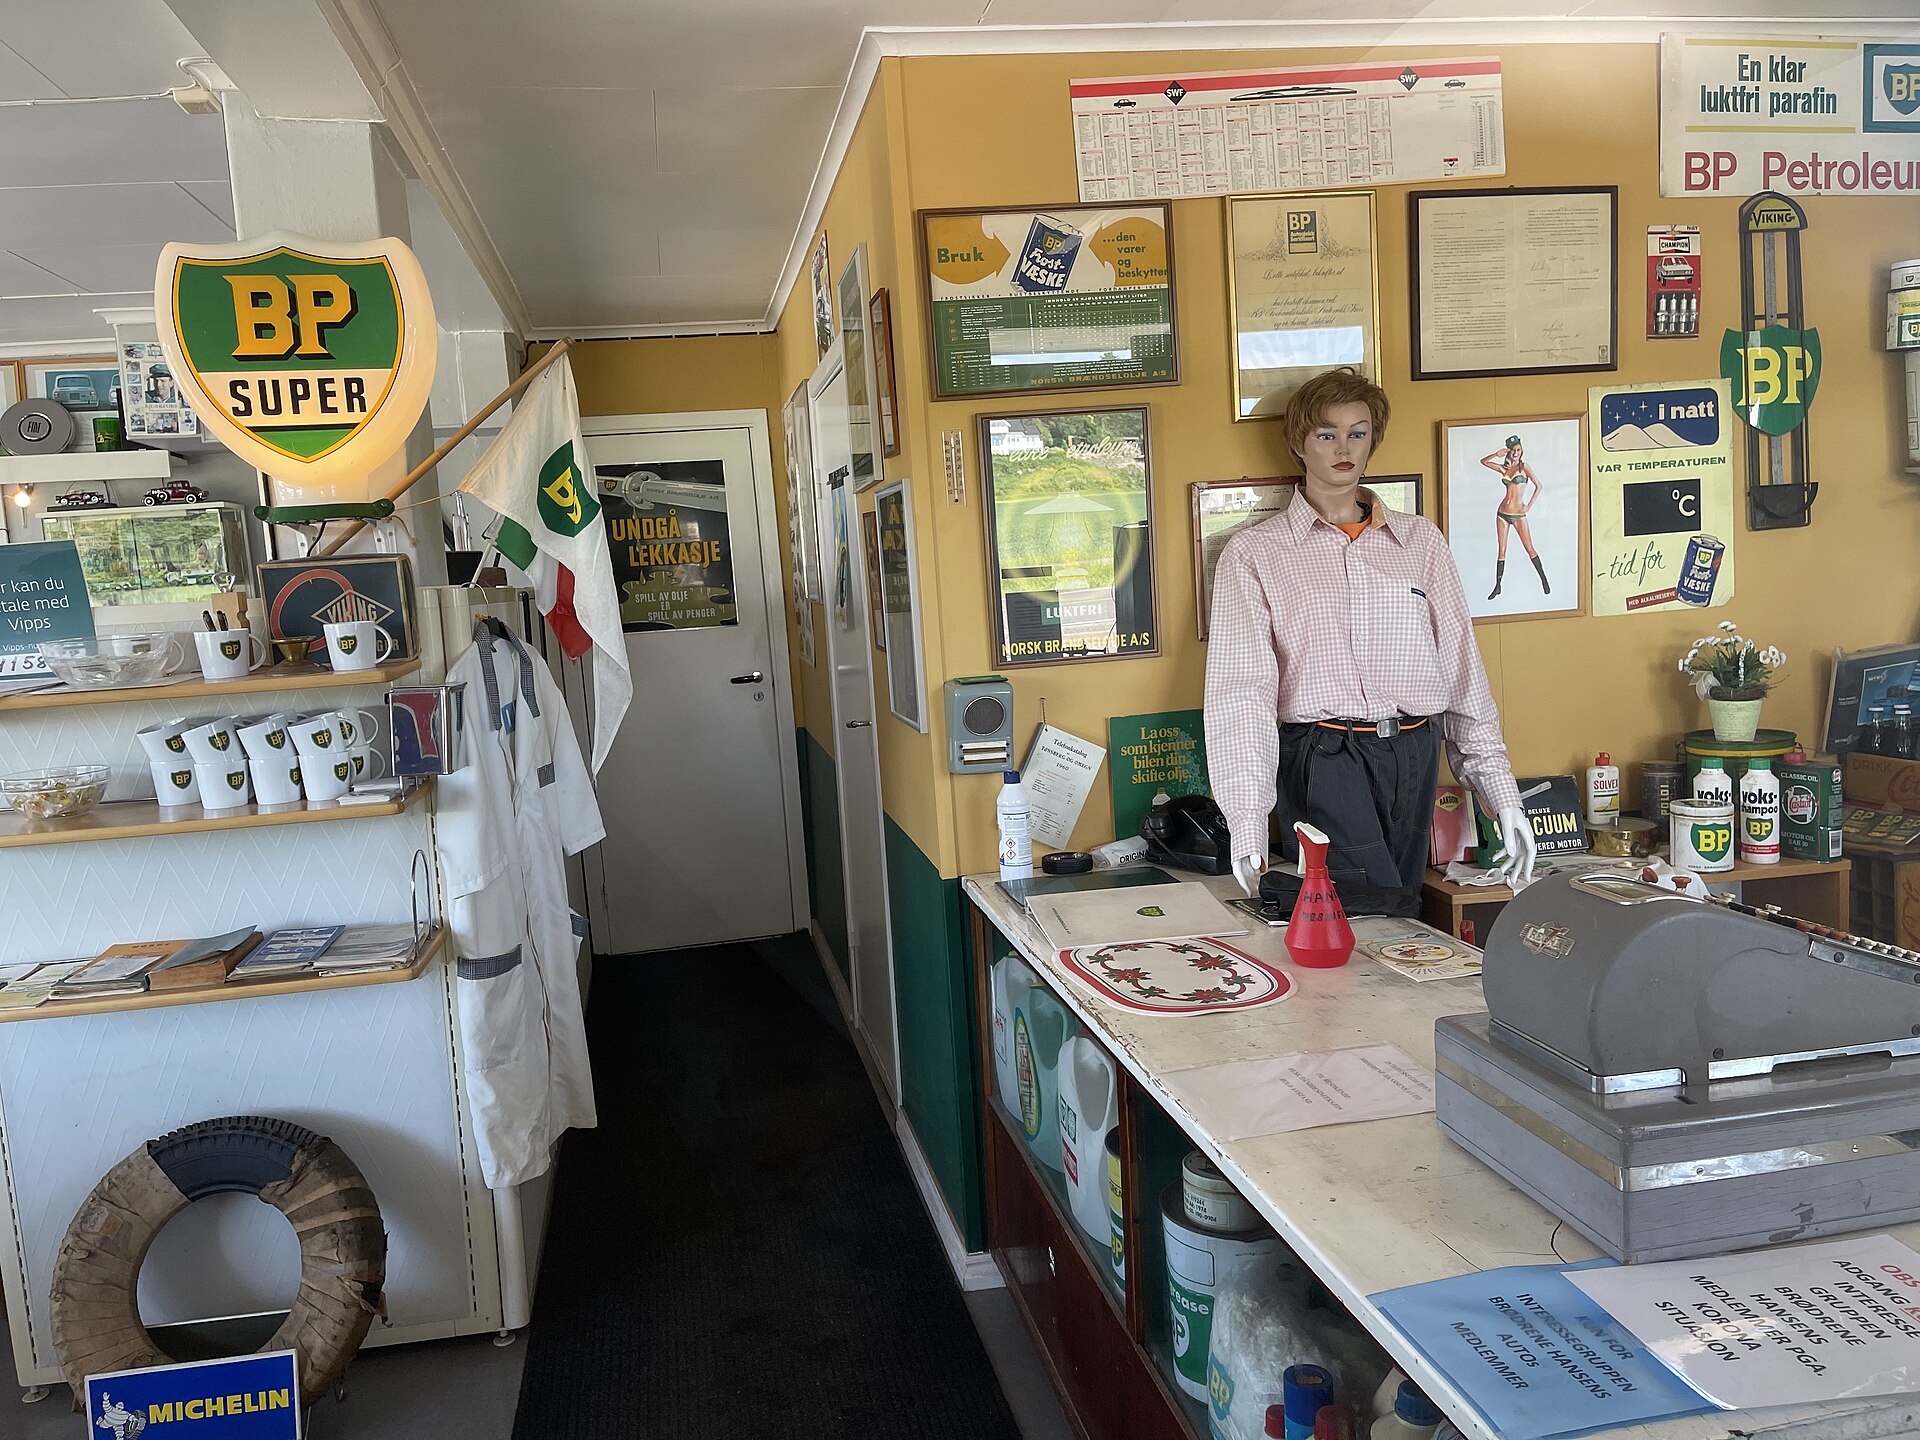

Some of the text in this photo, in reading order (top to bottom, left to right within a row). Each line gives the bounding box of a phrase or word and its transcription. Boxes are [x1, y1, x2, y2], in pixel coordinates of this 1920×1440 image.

[1738, 54, 1807, 83] En klar
[1400, 74, 1417, 84] SWF
[1166, 88, 1184, 98] SWF
[1700, 85, 1837, 117] luktfri parafin
[1684, 151, 1738, 191] BP
[1289, 213, 1311, 230] BP
[1752, 209, 1793, 228] VIKING
[1045, 236, 1062, 250] BP
[1117, 245, 1147, 254] varer
[937, 246, 984, 264] Bruk
[1117, 258, 1131, 268] og
[1021, 255, 1066, 287] VÆSKE
[1118, 267, 1168, 280] beskytter
[222, 274, 359, 362] BP
[1030, 377, 1064, 385] NORSK
[1068, 371, 1148, 383] BRÆNDSELOLJE
[1736, 346, 1813, 406] BP
[228, 376, 367, 418] SUPER
[1658, 401, 1716, 421] i natt
[27, 421, 41, 433] FIAT
[1597, 456, 1726, 473] VAR TEMPERATUREN
[611, 508, 681, 542] UNDGÅ
[628, 540, 721, 570] LEKKASJE
[1638, 540, 1666, 587] for
[1700, 552, 1711, 561] BP
[10, 576, 65, 594] kan du
[1684, 576, 1712, 592] VÆSKE
[0, 594, 70, 613] tale med
[634, 590, 688, 603] SPILL AV OLJE
[661, 601, 670, 610] ER
[326, 596, 378, 624] VIKING
[648, 608, 716, 621] SPILL AV PENGER
[1046, 603, 1103, 619] LUKTFRI
[7, 616, 51, 634] Vipps
[2, 643, 38, 652] Vipps-nu
[225, 644, 240, 655] BP
[340, 639, 355, 650] BP
[1002, 640, 1042, 656] NORSK
[1130, 632, 1150, 646] A/S
[213, 735, 228, 748] BP
[270, 733, 284, 746] BP
[315, 732, 330, 745] BP
[1140, 727, 1179, 740] La oss
[1120, 740, 1197, 756] som kjenner
[338, 766, 348, 777] BP
[1133, 756, 1164, 770] bilen
[176, 774, 190, 785] BP
[231, 774, 244, 786] BP
[1132, 769, 1166, 784] skifte
[1780, 772, 1807, 780] CLASSIC
[1660, 785, 1670, 816] POLDI
[1742, 788, 1778, 804] voks-
[1527, 807, 1551, 815] DELUXE
[1527, 813, 1578, 837] CUUM
[1749, 821, 1772, 836] BP
[1558, 838, 1582, 849] MOTOR
[1698, 829, 1730, 852] BP
[1120, 849, 1149, 864] ORIGIN
[1832, 1260, 1911, 1309] ADGANG
[1170, 1282, 1209, 1315] rease
[1749, 1293, 1829, 1346] HANSENS
[1774, 1286, 1867, 1347] BRØDRENE
[1809, 1286, 1892, 1340] GRUPPEN
[1834, 1281, 1920, 1340] INTERESSE
[1655, 1301, 1741, 1362] SITUASJON
[1690, 1275, 1827, 1376] MEDLEMMER PGA.
[1692, 1302, 1762, 1352] KORONA
[1516, 1293, 1638, 1393] INTERESSEGRUPPEN
[1574, 1314, 1634, 1360] KUN FOR
[1450, 1321, 1529, 1389] MEDLEMMER
[1488, 1296, 1612, 1399] BRØDRENE HANSENS
[1210, 1364, 1230, 1409] BP
[149, 1388, 290, 1424] MICHELIN
